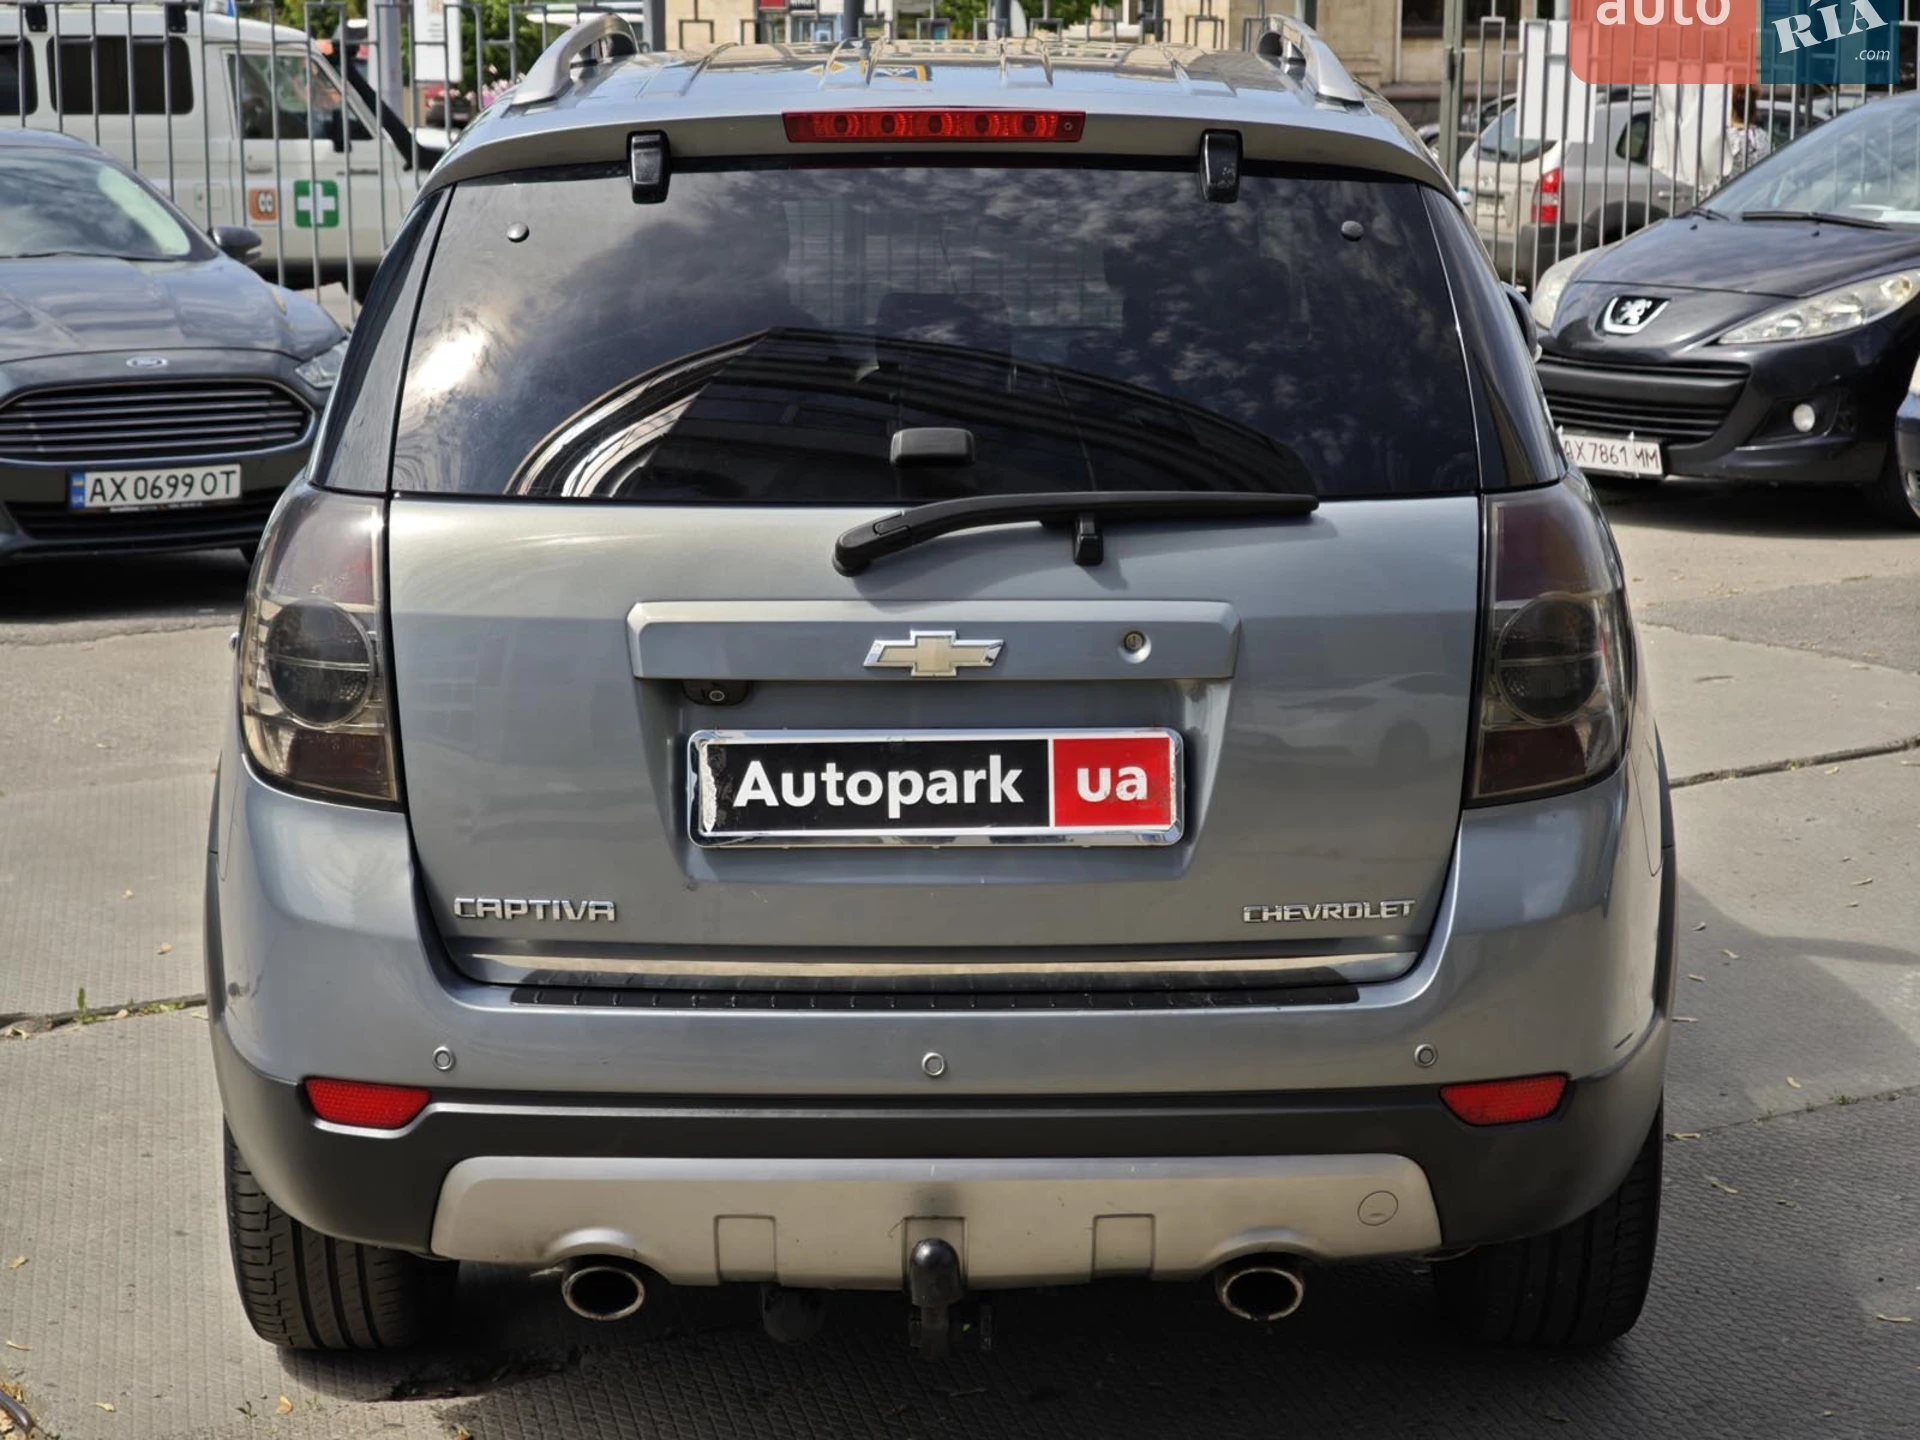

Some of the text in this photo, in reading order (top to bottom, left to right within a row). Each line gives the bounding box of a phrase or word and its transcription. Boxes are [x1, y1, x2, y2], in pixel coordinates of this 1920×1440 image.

[1588, 442, 1628, 467] 7861
[89, 470, 236, 503] AX 0699 OT
[733, 754, 1148, 819] Autopark ua
[453, 897, 615, 922] CAPTIVA
[1243, 899, 1415, 923] CHEVROLET
